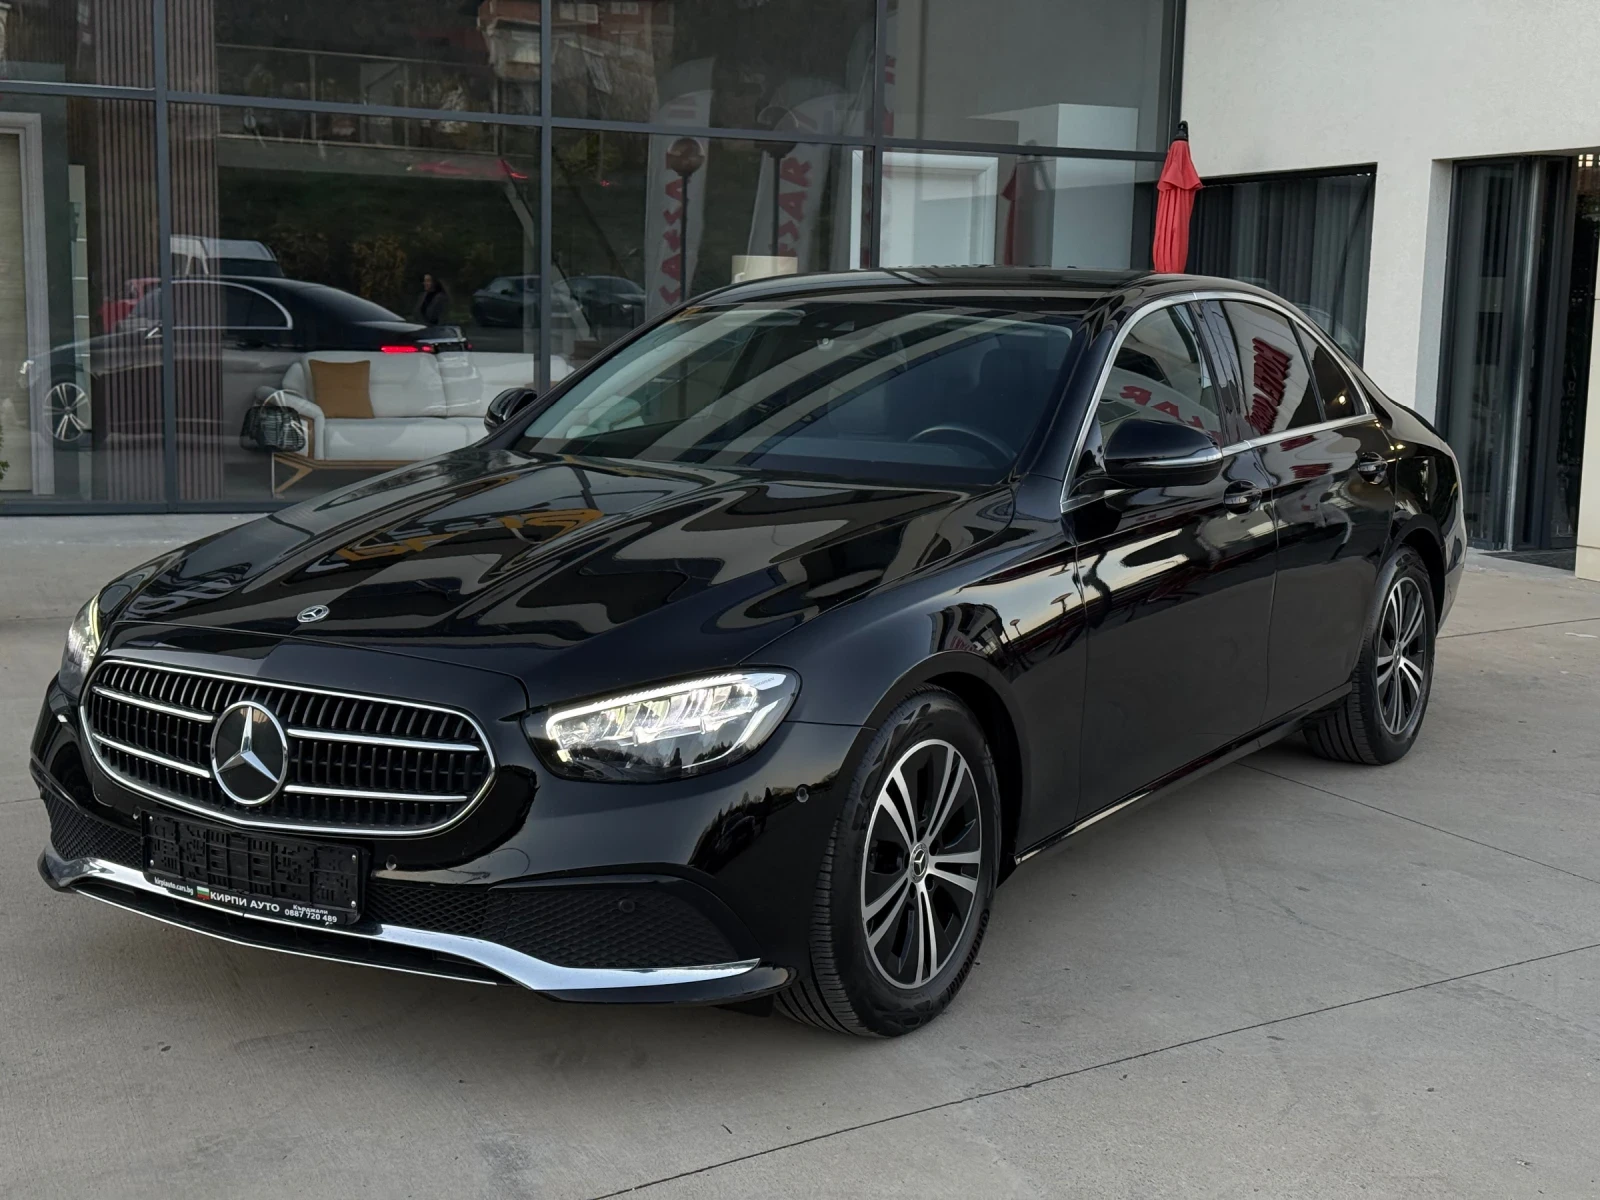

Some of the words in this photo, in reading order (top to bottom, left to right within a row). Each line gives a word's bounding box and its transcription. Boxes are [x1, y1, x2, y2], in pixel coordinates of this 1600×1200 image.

[154, 876, 194, 896] kirpiauto.cars.bg
[210, 891, 248, 907] КИРПИ
[249, 900, 280, 913] АУТО
[293, 904, 329, 915] Кърджали
[284, 908, 304, 918] 0887
[306, 911, 321, 921] 720
[322, 914, 338, 923] 489
